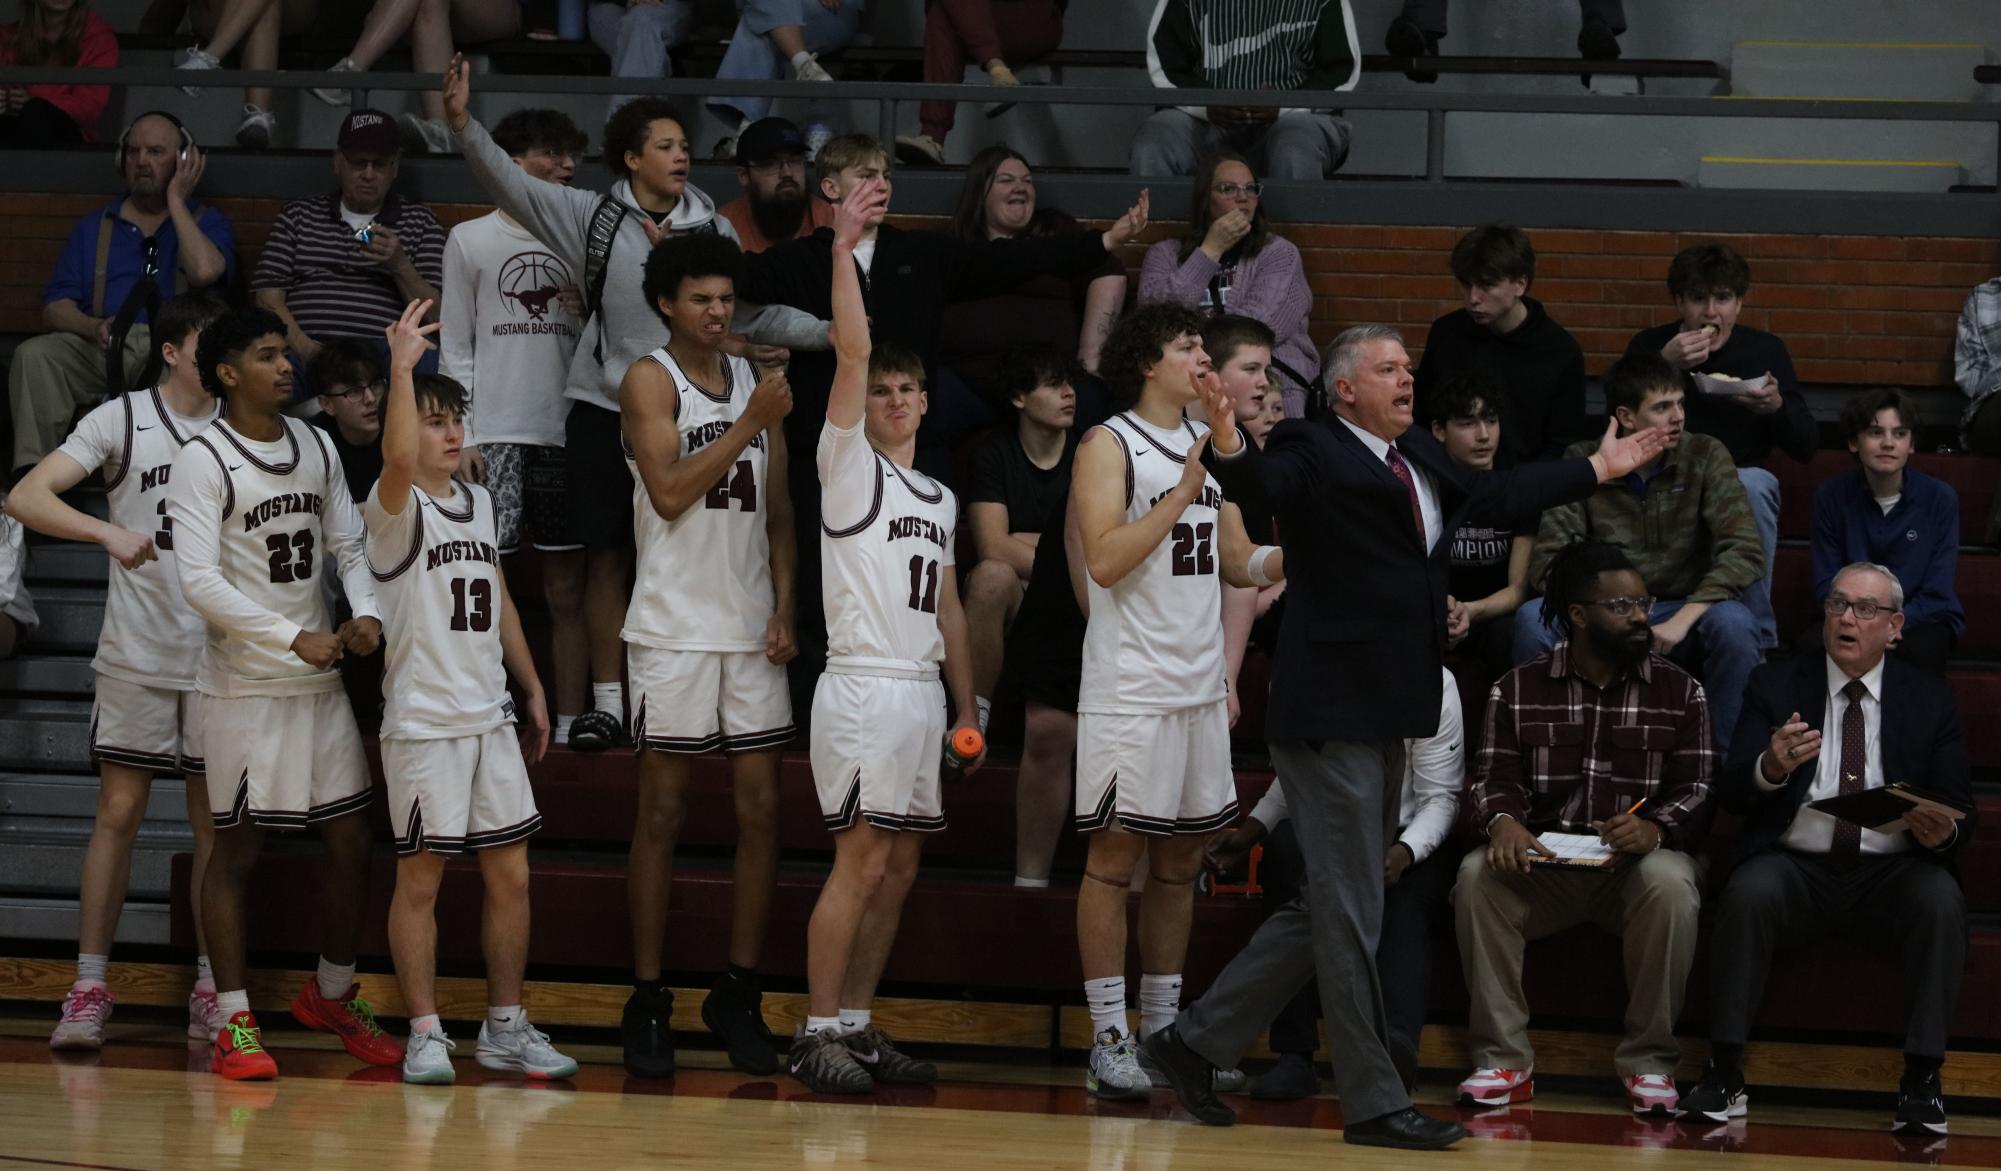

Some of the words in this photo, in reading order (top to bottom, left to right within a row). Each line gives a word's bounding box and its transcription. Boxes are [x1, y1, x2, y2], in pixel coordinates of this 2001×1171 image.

[492, 323, 530, 336] MUSTANG
[705, 460, 757, 512] 24
[265, 528, 315, 583] 23
[1171, 522, 1214, 576] 22
[450, 577, 492, 632] 13
[908, 554, 939, 614] 11
